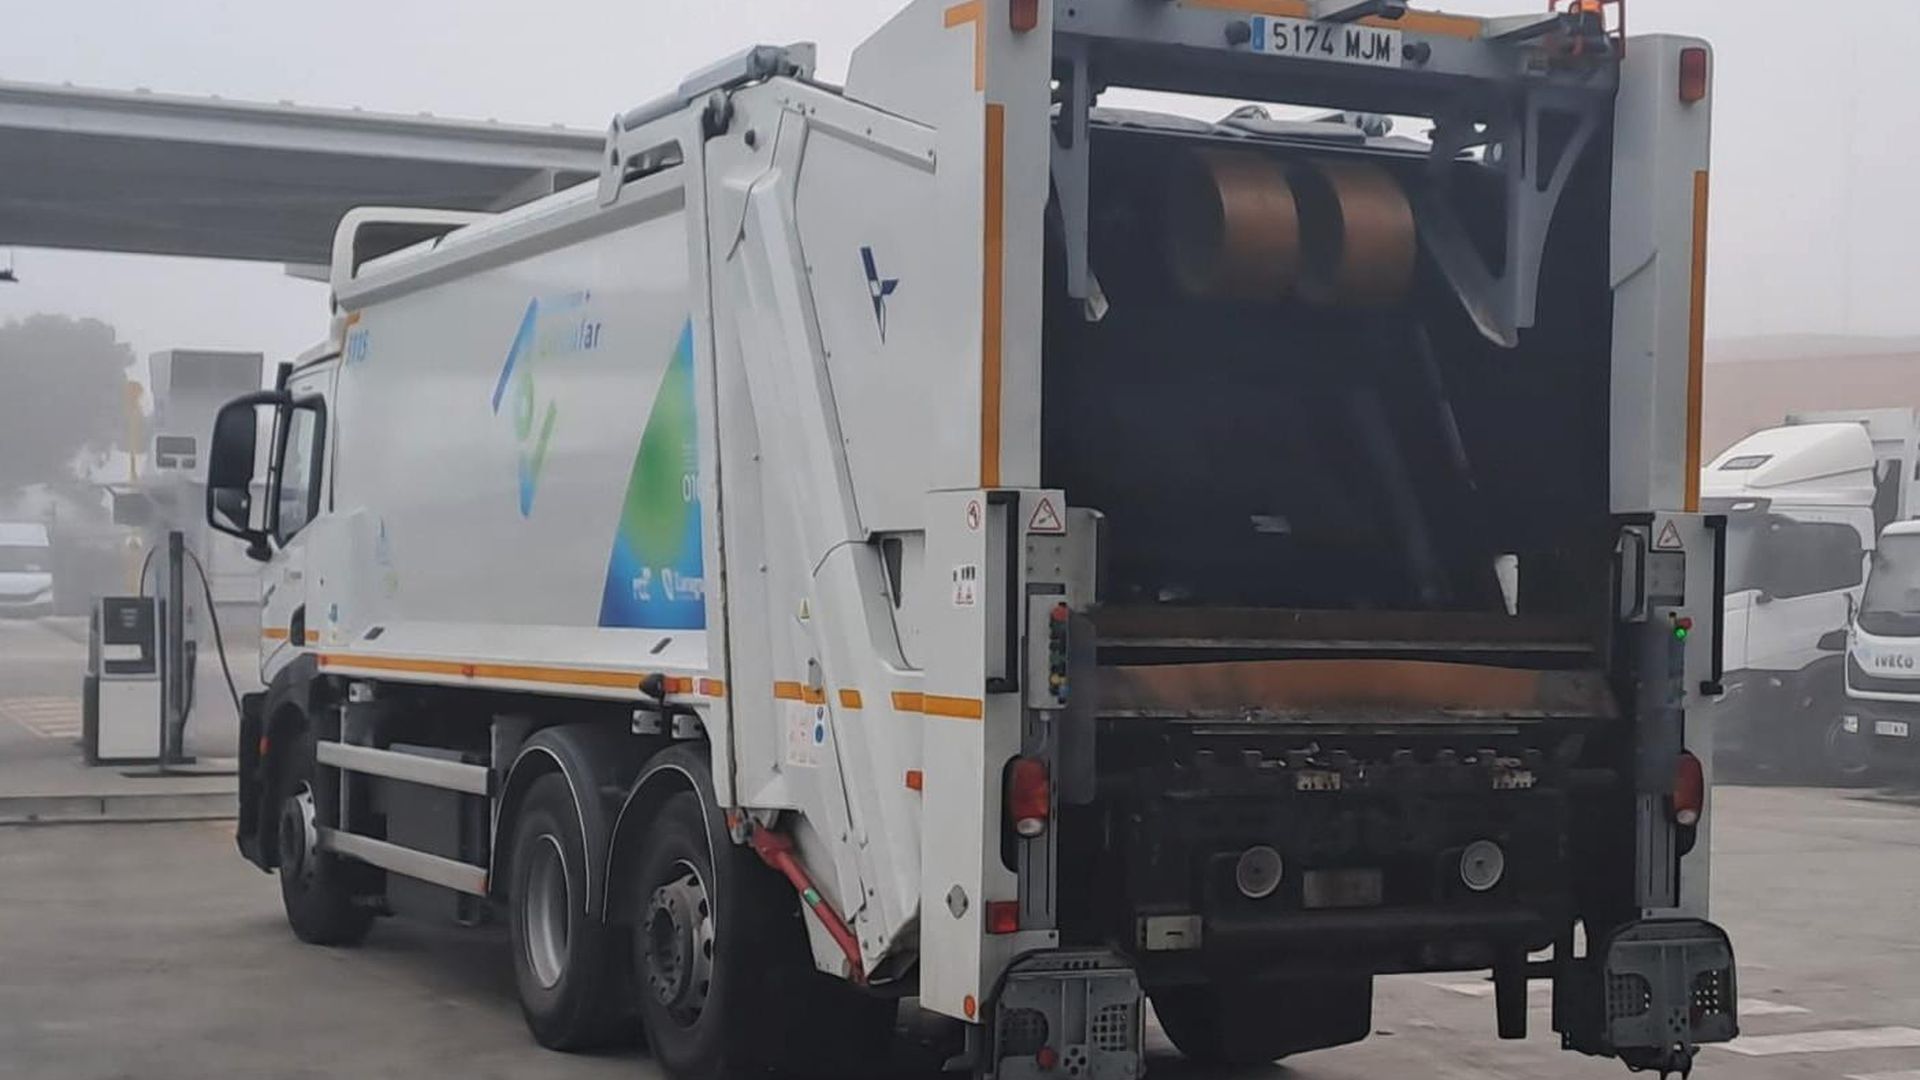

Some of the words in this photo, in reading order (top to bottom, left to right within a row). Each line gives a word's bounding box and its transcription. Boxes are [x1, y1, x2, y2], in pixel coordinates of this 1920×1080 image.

[1273, 22, 1334, 55] 5174
[1346, 30, 1391, 62] MJM
[1875, 654, 1914, 669] IVECO
